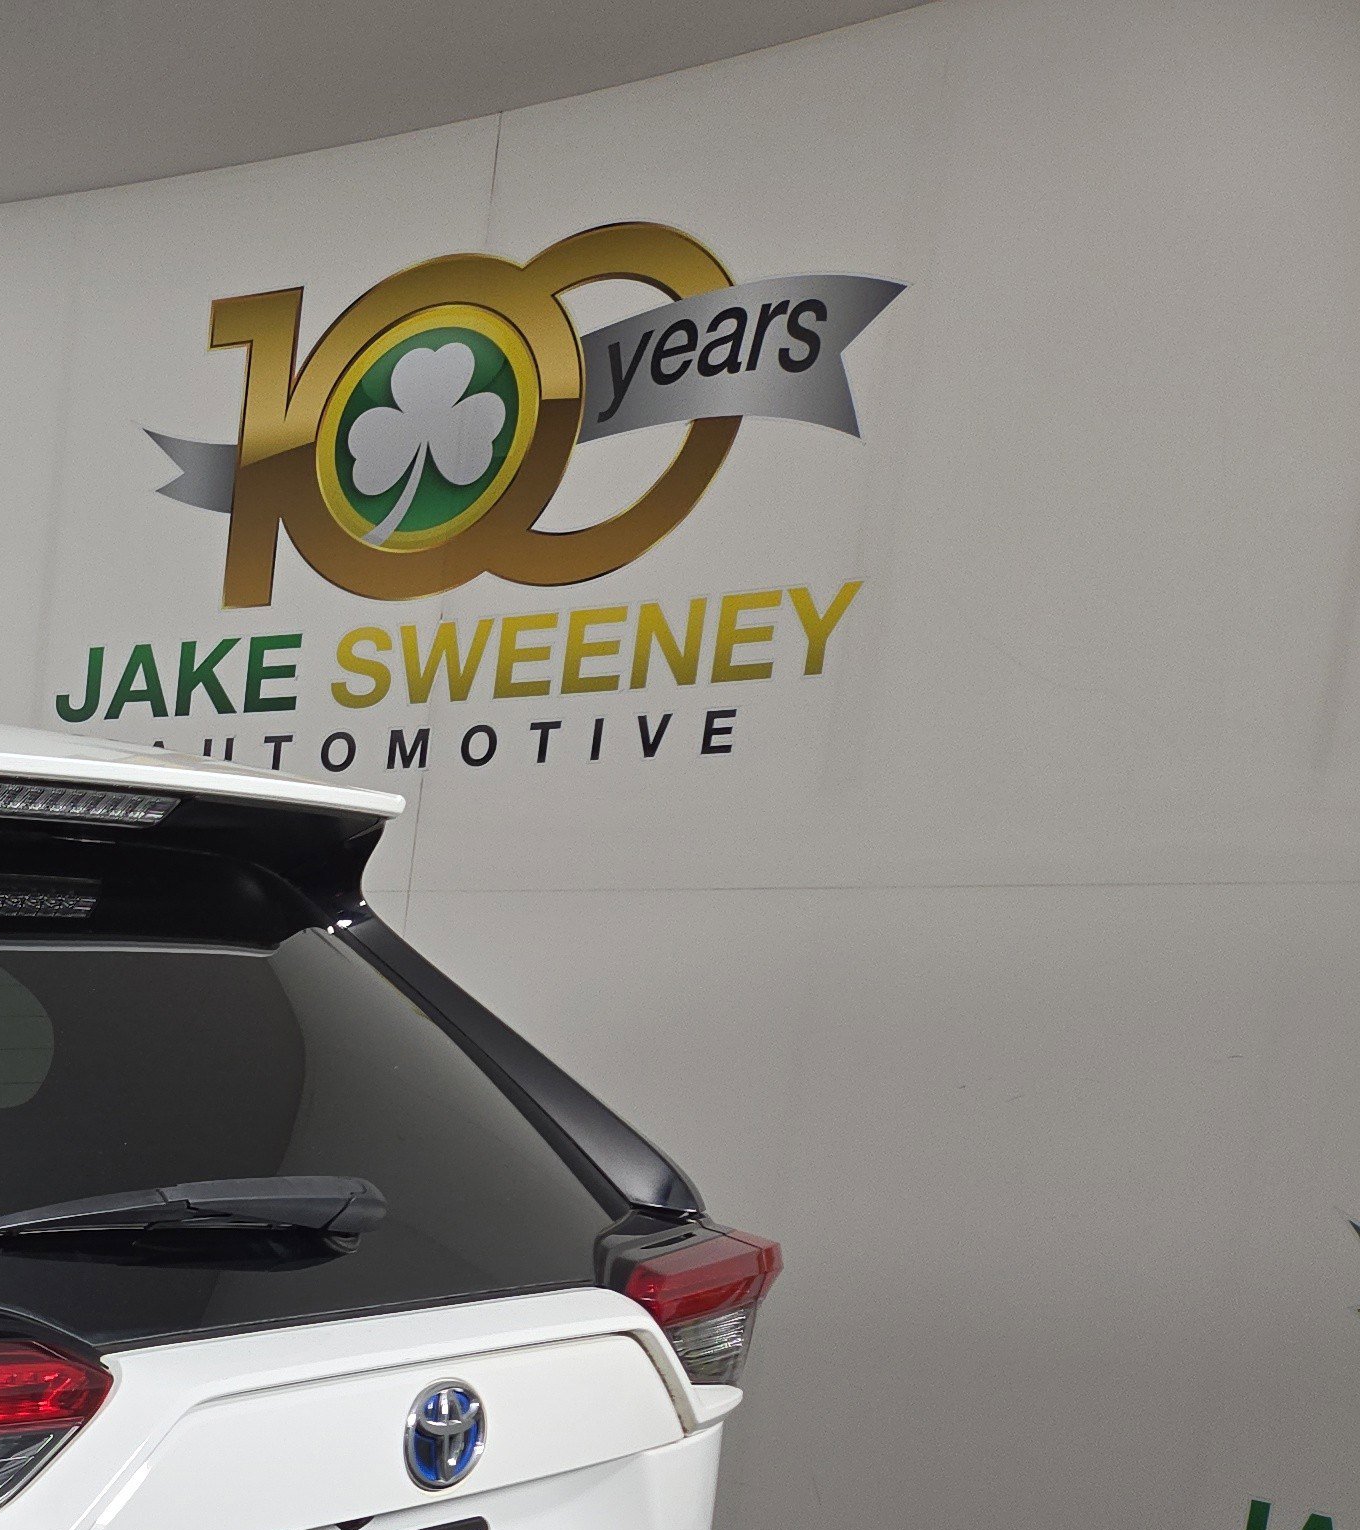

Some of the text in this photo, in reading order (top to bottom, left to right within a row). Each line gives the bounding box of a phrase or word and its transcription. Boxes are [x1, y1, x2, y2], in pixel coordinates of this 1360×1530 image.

[597, 297, 827, 423] years
[56, 580, 863, 723] JAKE SWEENEY
[153, 710, 737, 775] TOMOTIVE
